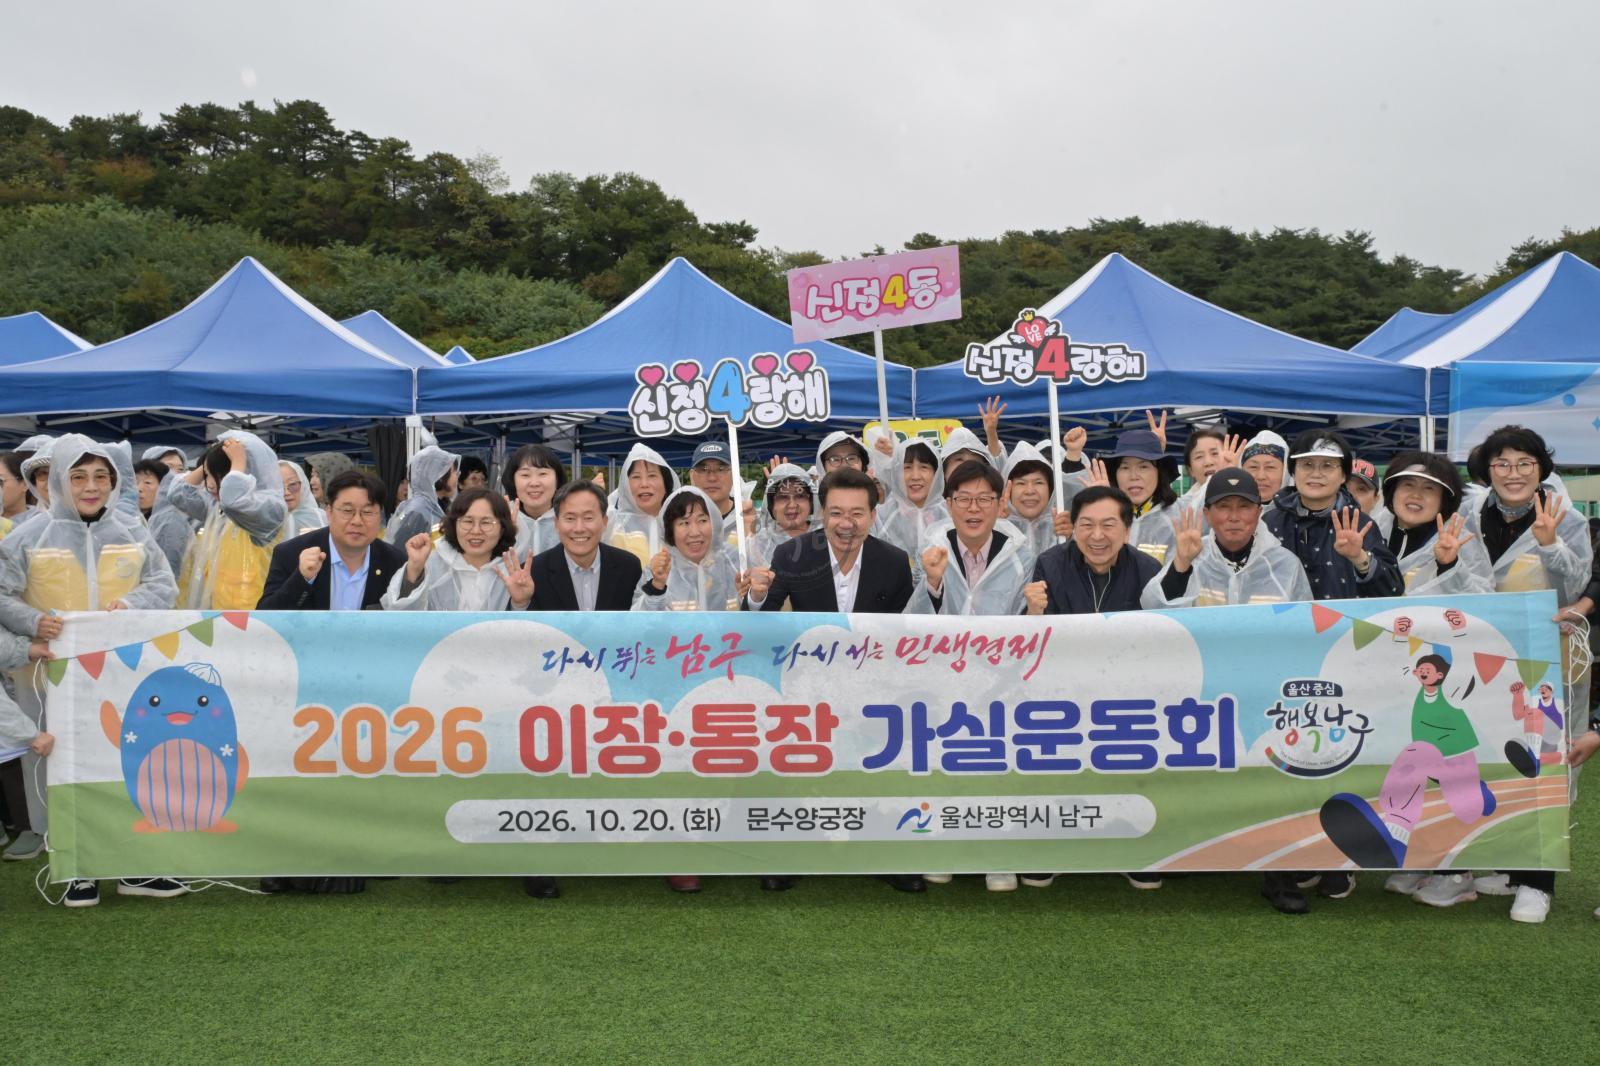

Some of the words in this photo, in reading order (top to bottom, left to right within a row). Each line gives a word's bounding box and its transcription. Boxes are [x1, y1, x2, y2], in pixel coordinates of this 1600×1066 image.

[806, 267, 941, 322] 신정4동
[968, 338, 1140, 380] 신정4랑해
[632, 360, 827, 433] 신정4랑해
[543, 647, 606, 676] 다시
[612, 641, 656, 679] 뛰는
[665, 632, 751, 682] 남구
[772, 640, 840, 672] 다시
[895, 626, 1052, 681] 민생경제
[292, 706, 487, 775] 2026
[519, 702, 839, 775] 이장·통장
[862, 696, 1236, 772] 가실운동회
[498, 809, 576, 832] 2026.
[586, 809, 625, 832] 10.
[633, 809, 674, 832] 20.
[682, 808, 721, 832] (화)
[747, 807, 866, 832] 문수양궁장
[940, 805, 1050, 829] 울산광역시
[1060, 805, 1103, 828] 남구
